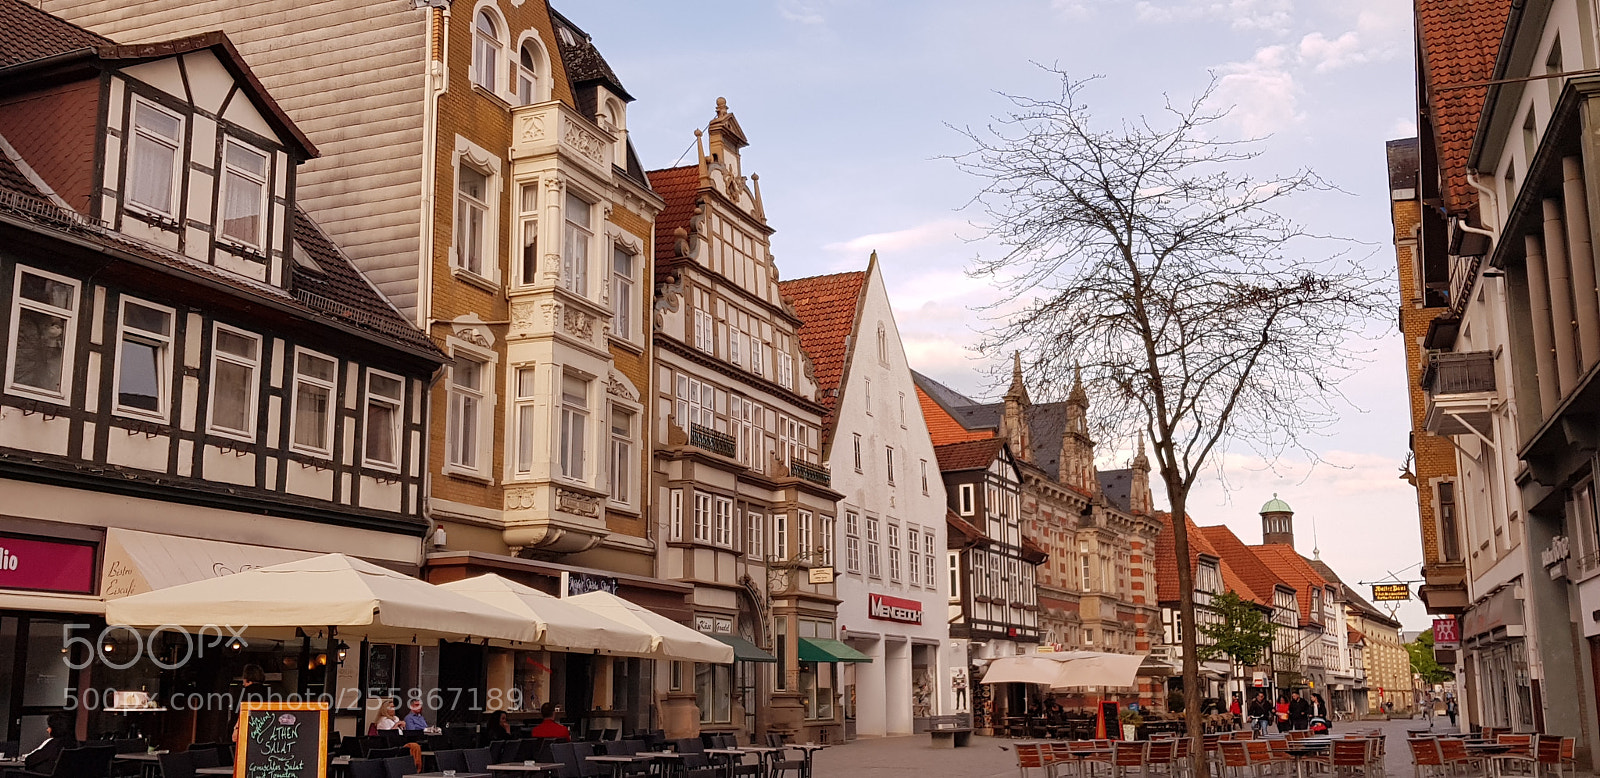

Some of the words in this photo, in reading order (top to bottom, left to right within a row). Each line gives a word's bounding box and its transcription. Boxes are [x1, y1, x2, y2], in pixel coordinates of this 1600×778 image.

[108, 561, 133, 577] Bistro
[269, 722, 302, 741] ATHEN
[261, 741, 296, 755] SALAT
